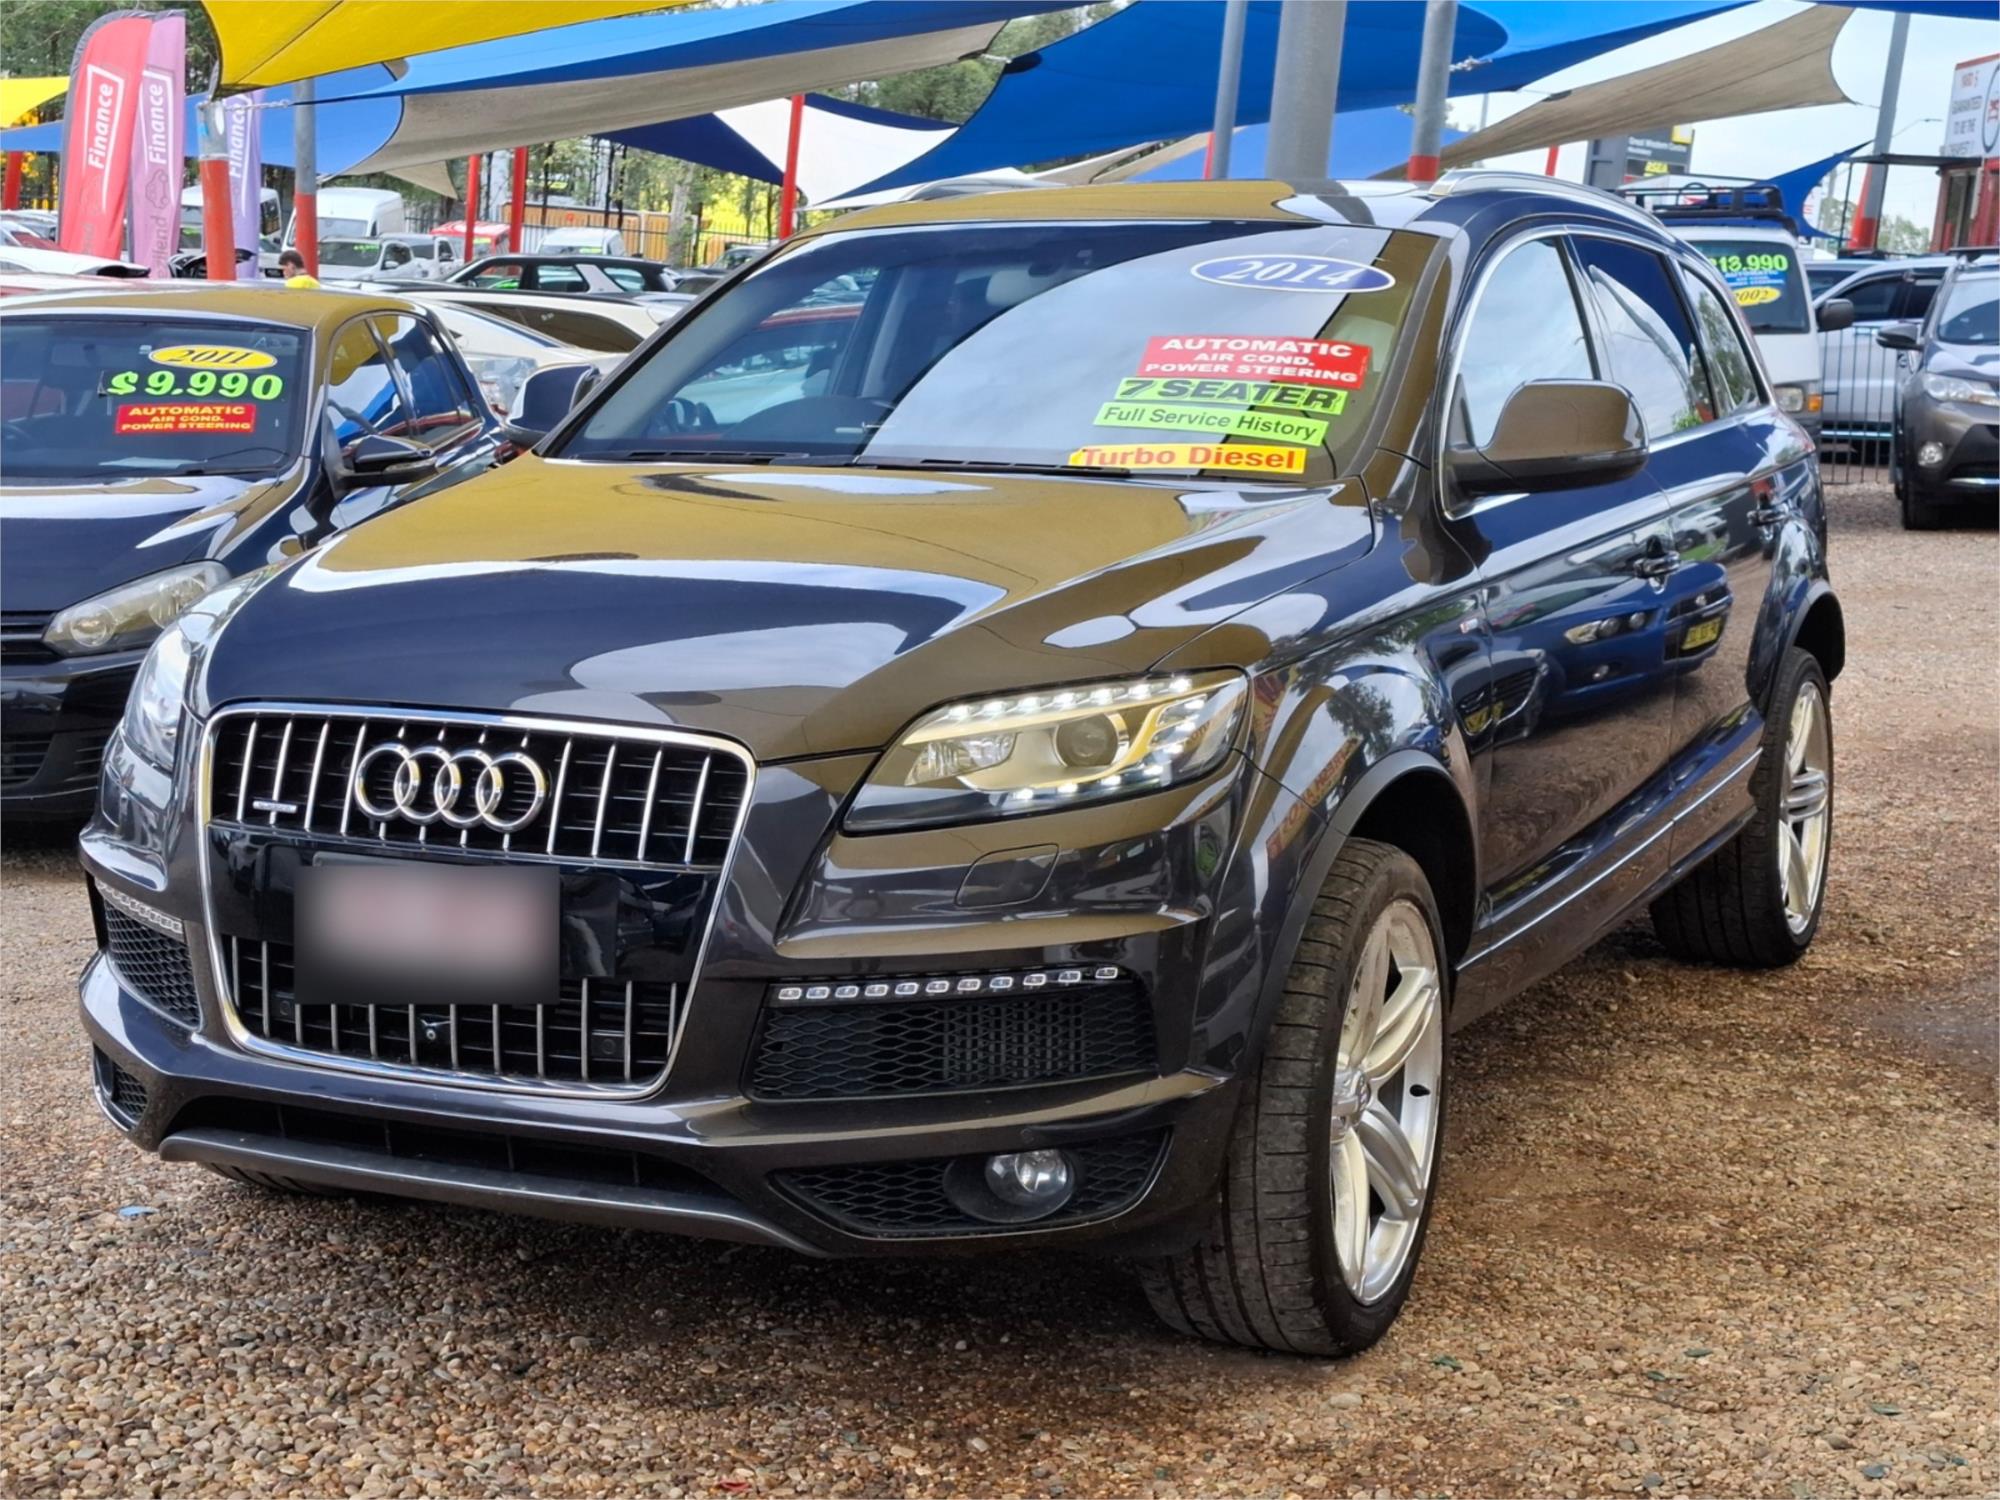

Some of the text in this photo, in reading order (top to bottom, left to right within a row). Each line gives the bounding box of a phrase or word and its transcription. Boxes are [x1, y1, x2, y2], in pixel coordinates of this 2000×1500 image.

[88, 83, 114, 169] Finance
[148, 84, 167, 164] Finance
[1219, 260, 1361, 286] 2014
[168, 350, 252, 364] 2011
[1161, 338, 1353, 358] AUTOMATIC
[1194, 352, 1316, 367] AIR COND.
[1145, 363, 1358, 383] POWER STEERING
[1120, 379, 1339, 410] 7 SEATER
[128, 406, 246, 416] AUTOMATIC
[121, 422, 251, 431] POWER STEERING
[1103, 406, 1318, 441] Full Service History
[1084, 446, 1295, 469] Turbo Diesel
